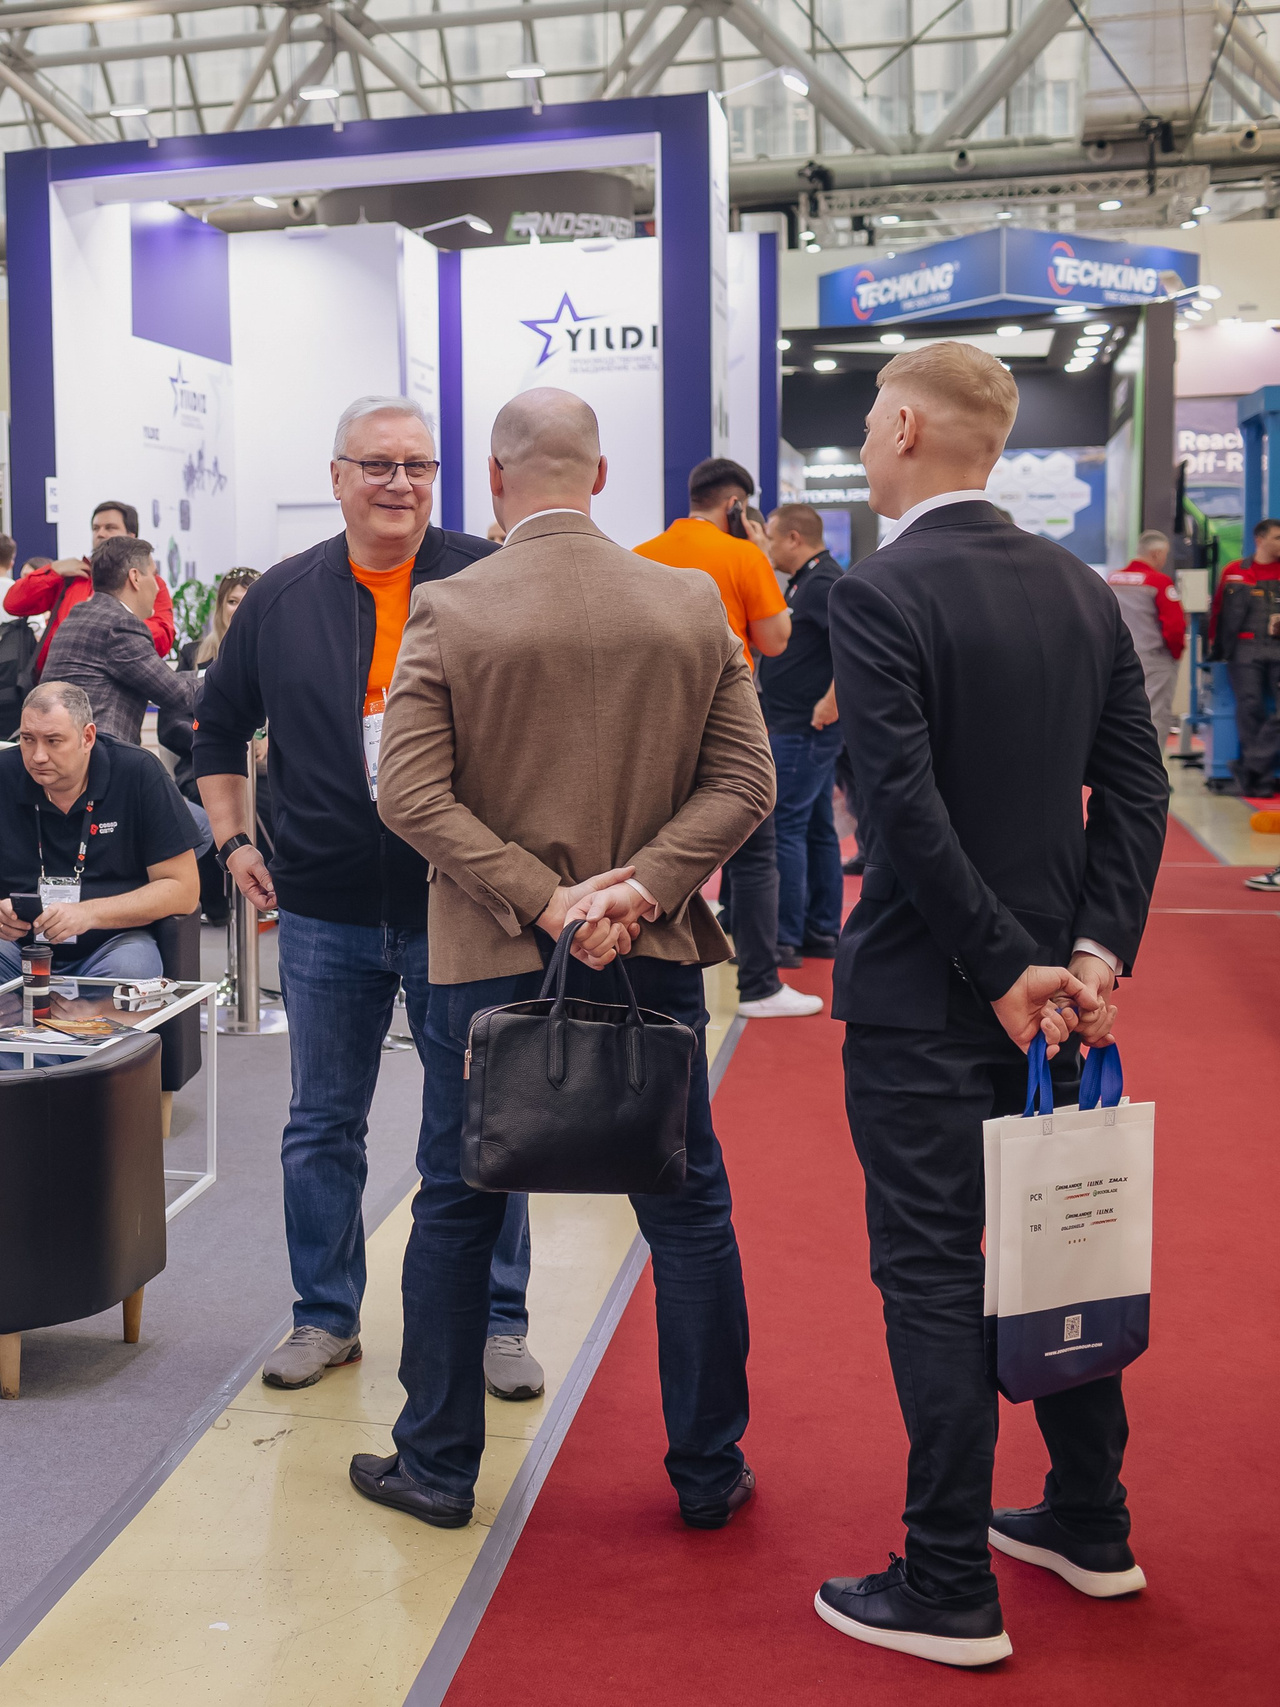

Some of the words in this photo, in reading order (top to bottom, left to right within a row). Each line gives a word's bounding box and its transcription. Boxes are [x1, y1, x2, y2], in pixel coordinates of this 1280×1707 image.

[1053, 256, 1158, 294] TECHKING
[855, 262, 954, 310] TECHKING
[1108, 1176, 1128, 1184] ZMAX
[1029, 1193, 1043, 1202] PCR
[1029, 1224, 1042, 1232] TBR
